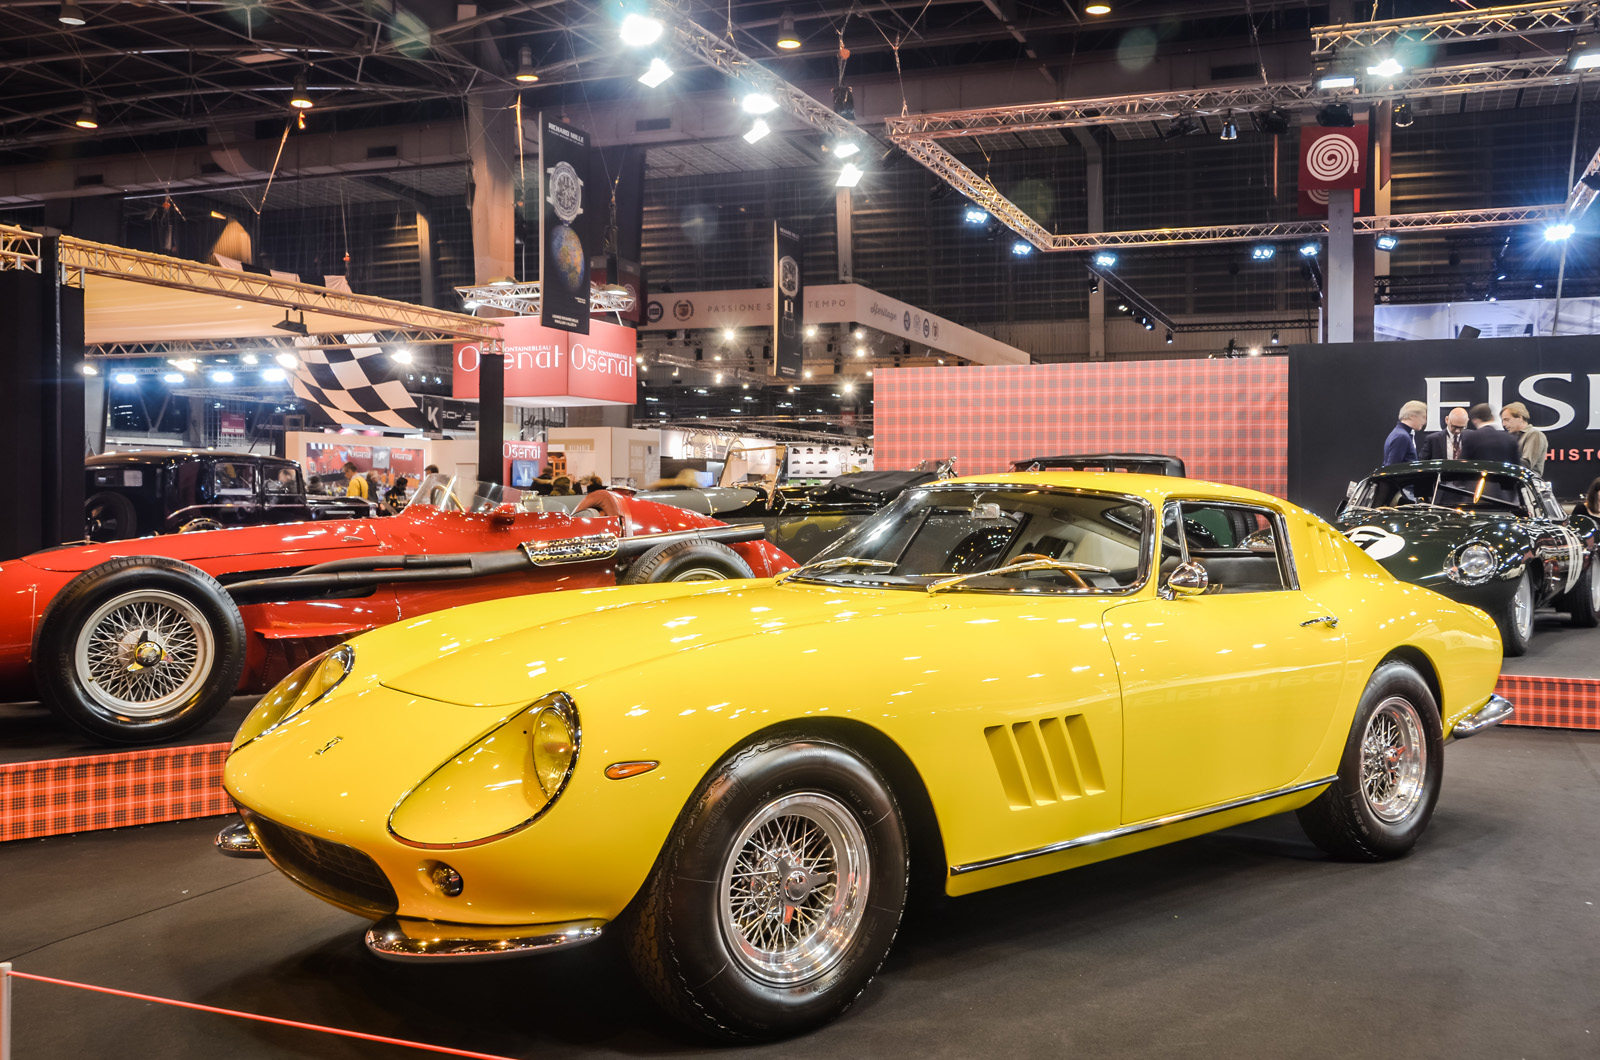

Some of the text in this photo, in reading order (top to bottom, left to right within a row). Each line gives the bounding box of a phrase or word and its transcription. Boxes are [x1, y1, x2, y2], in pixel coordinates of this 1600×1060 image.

[707, 303, 761, 313] PASSIONE
[808, 299, 846, 309] TEMPO
[870, 302, 898, 322] Heritage
[458, 345, 563, 371] Oenat
[571, 343, 634, 377] Osenat
[1424, 373, 1600, 432] FIS
[503, 442, 542, 458] Osenat
[1544, 448, 1600, 461] HIST
[696, 783, 740, 850] MICHELIN
